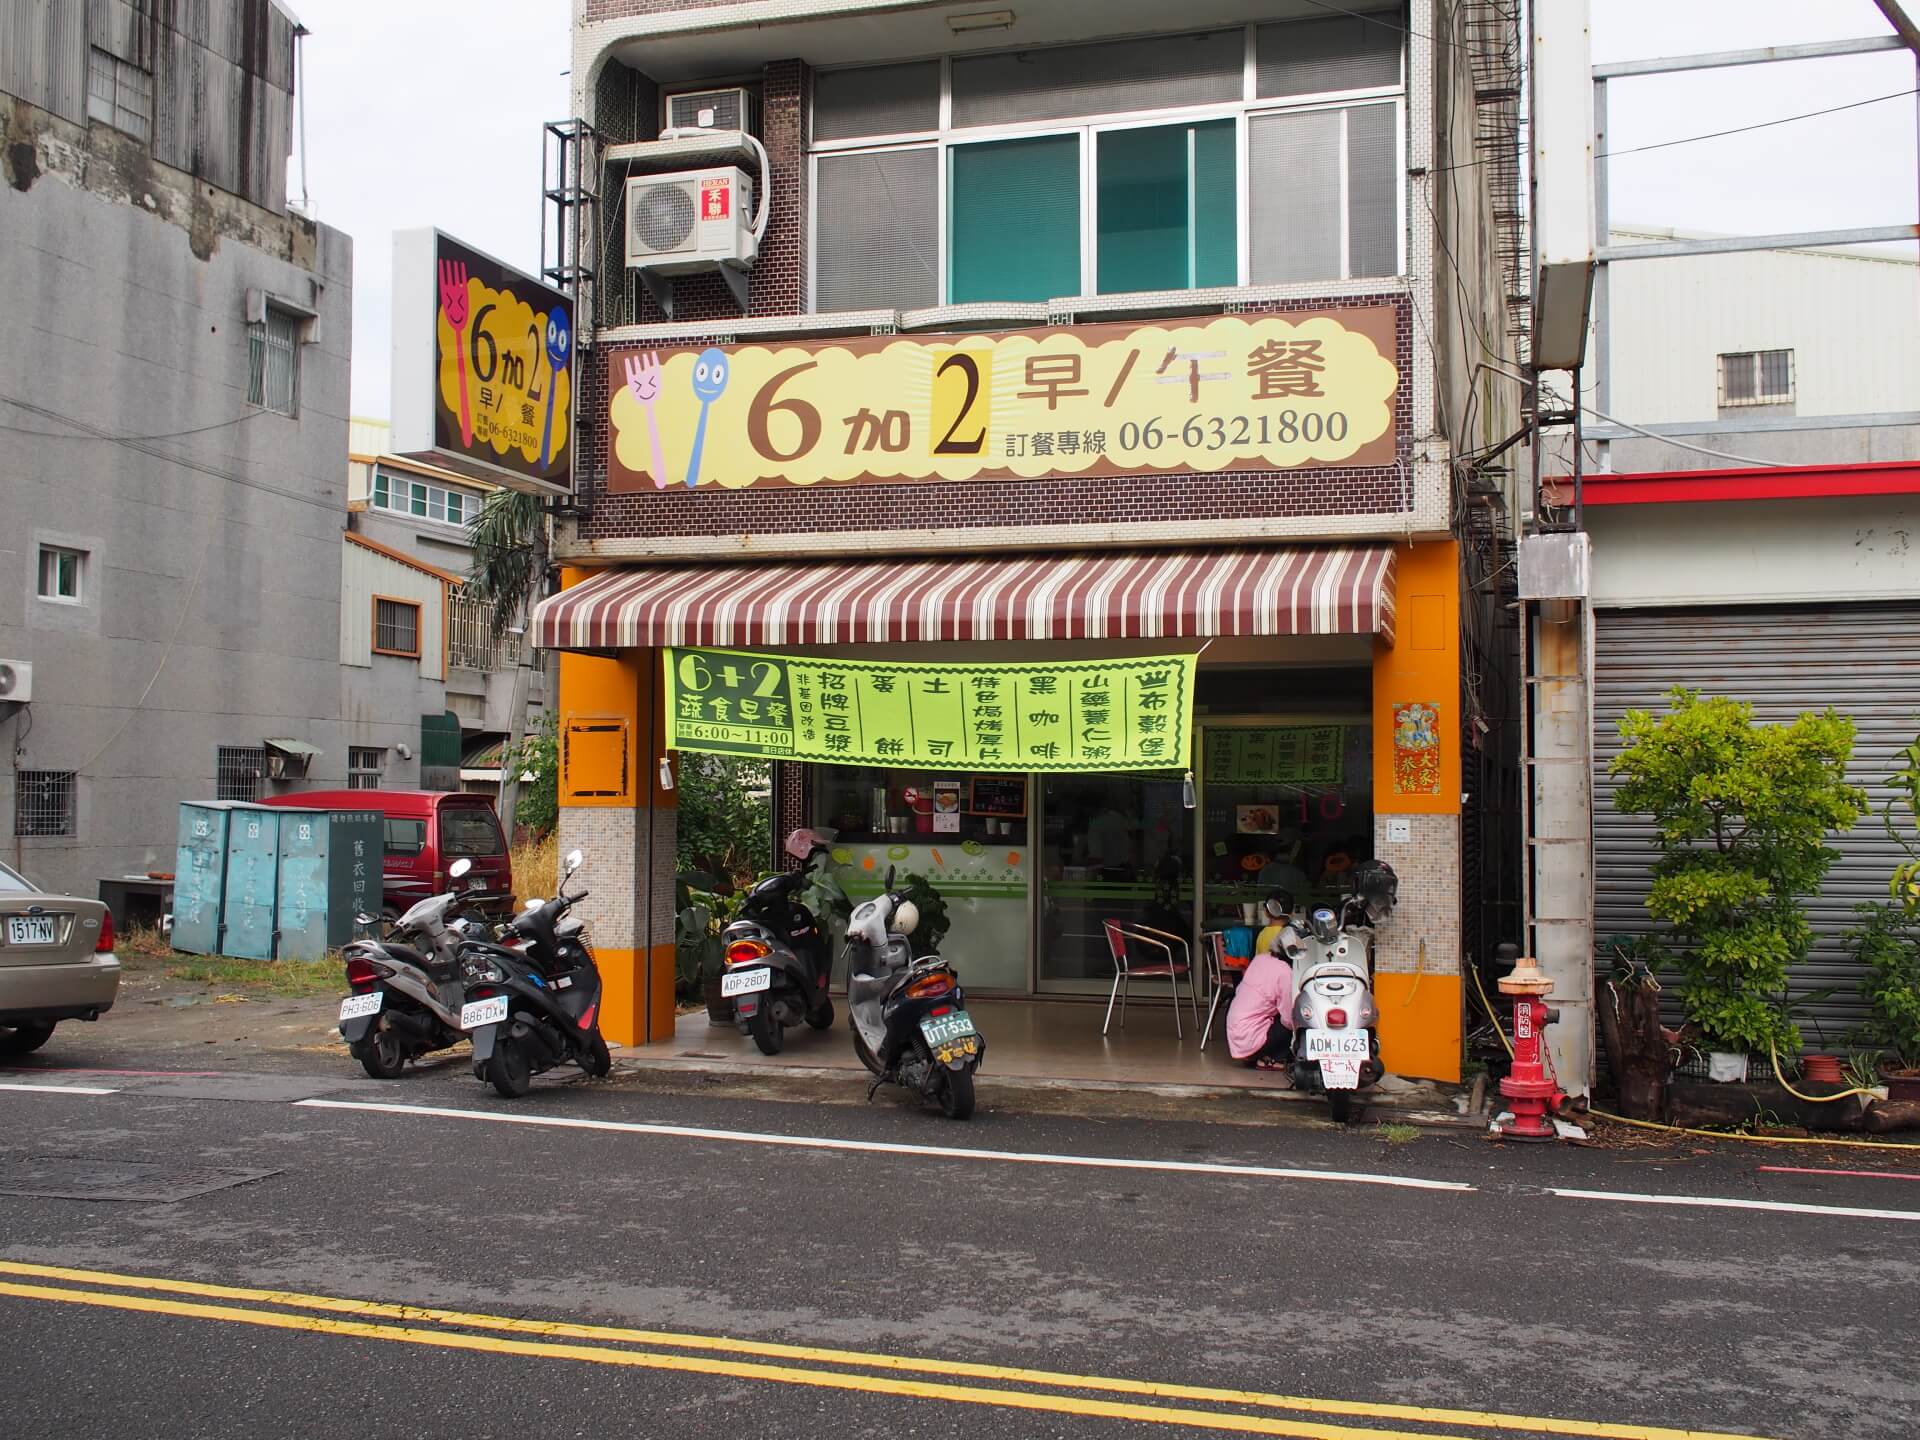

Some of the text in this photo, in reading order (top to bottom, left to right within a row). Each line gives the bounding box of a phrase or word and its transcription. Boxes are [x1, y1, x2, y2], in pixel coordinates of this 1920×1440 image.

[489, 422, 538, 449] 06-6321800
[1005, 429, 1107, 457] 訂餐專線
[1118, 410, 1348, 451] 06-6321800
[678, 654, 784, 699] 6+2
[679, 694, 788, 727] 蔬食早餐
[796, 673, 816, 740] 非基因改造
[817, 671, 852, 753] 招牌豆漿
[870, 674, 904, 756] 蛋餅
[922, 677, 954, 758] 土司
[971, 676, 1004, 760] 特色焗烤厚片
[1028, 675, 1061, 759] 黑咖啡
[1080, 674, 1112, 759] 山藥薏仁粥
[694, 725, 789, 745] 6:00~11:00
[1419, 752, 1435, 785] 大家
[724, 974, 768, 993] ADP-2807
